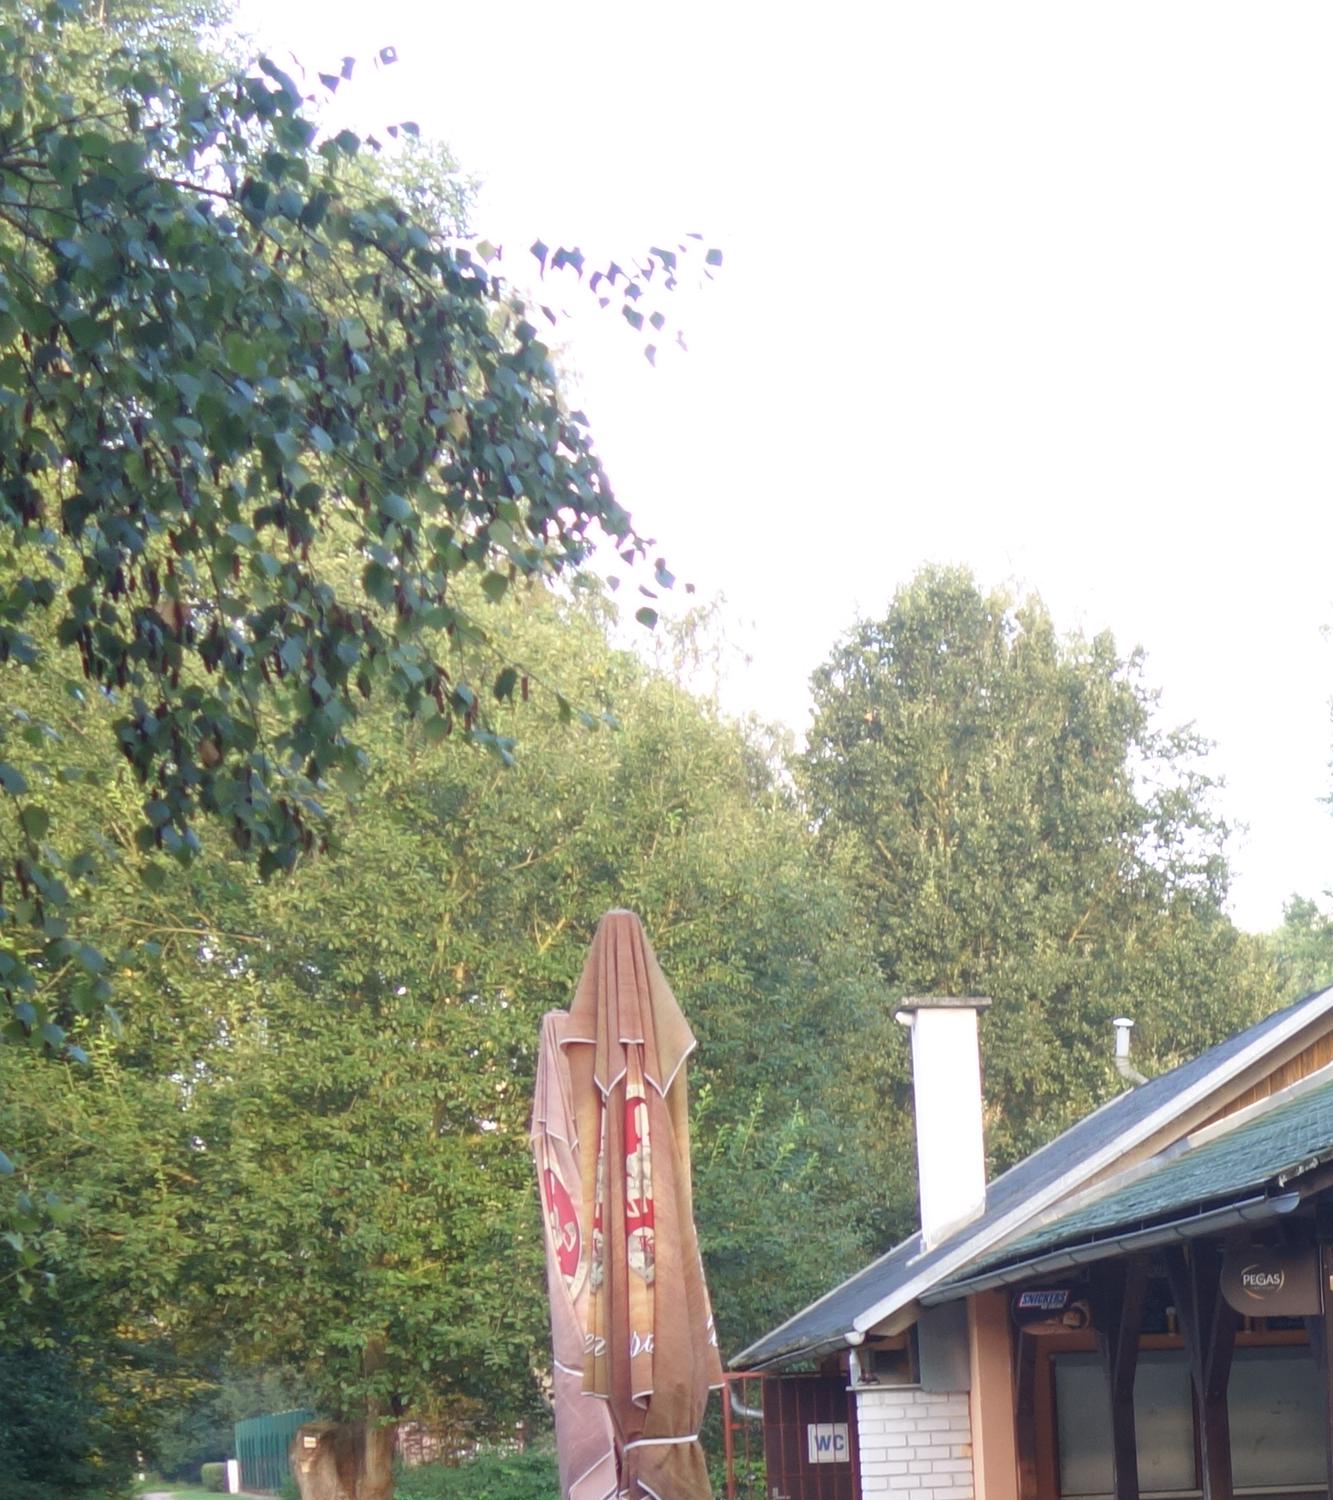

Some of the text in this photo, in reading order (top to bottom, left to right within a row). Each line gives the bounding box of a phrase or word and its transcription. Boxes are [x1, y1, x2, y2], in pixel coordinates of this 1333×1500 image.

[1242, 1273, 1281, 1287] PEGAS
[1021, 1292, 1066, 1305] SNICKERS
[814, 1434, 845, 1452] WC
